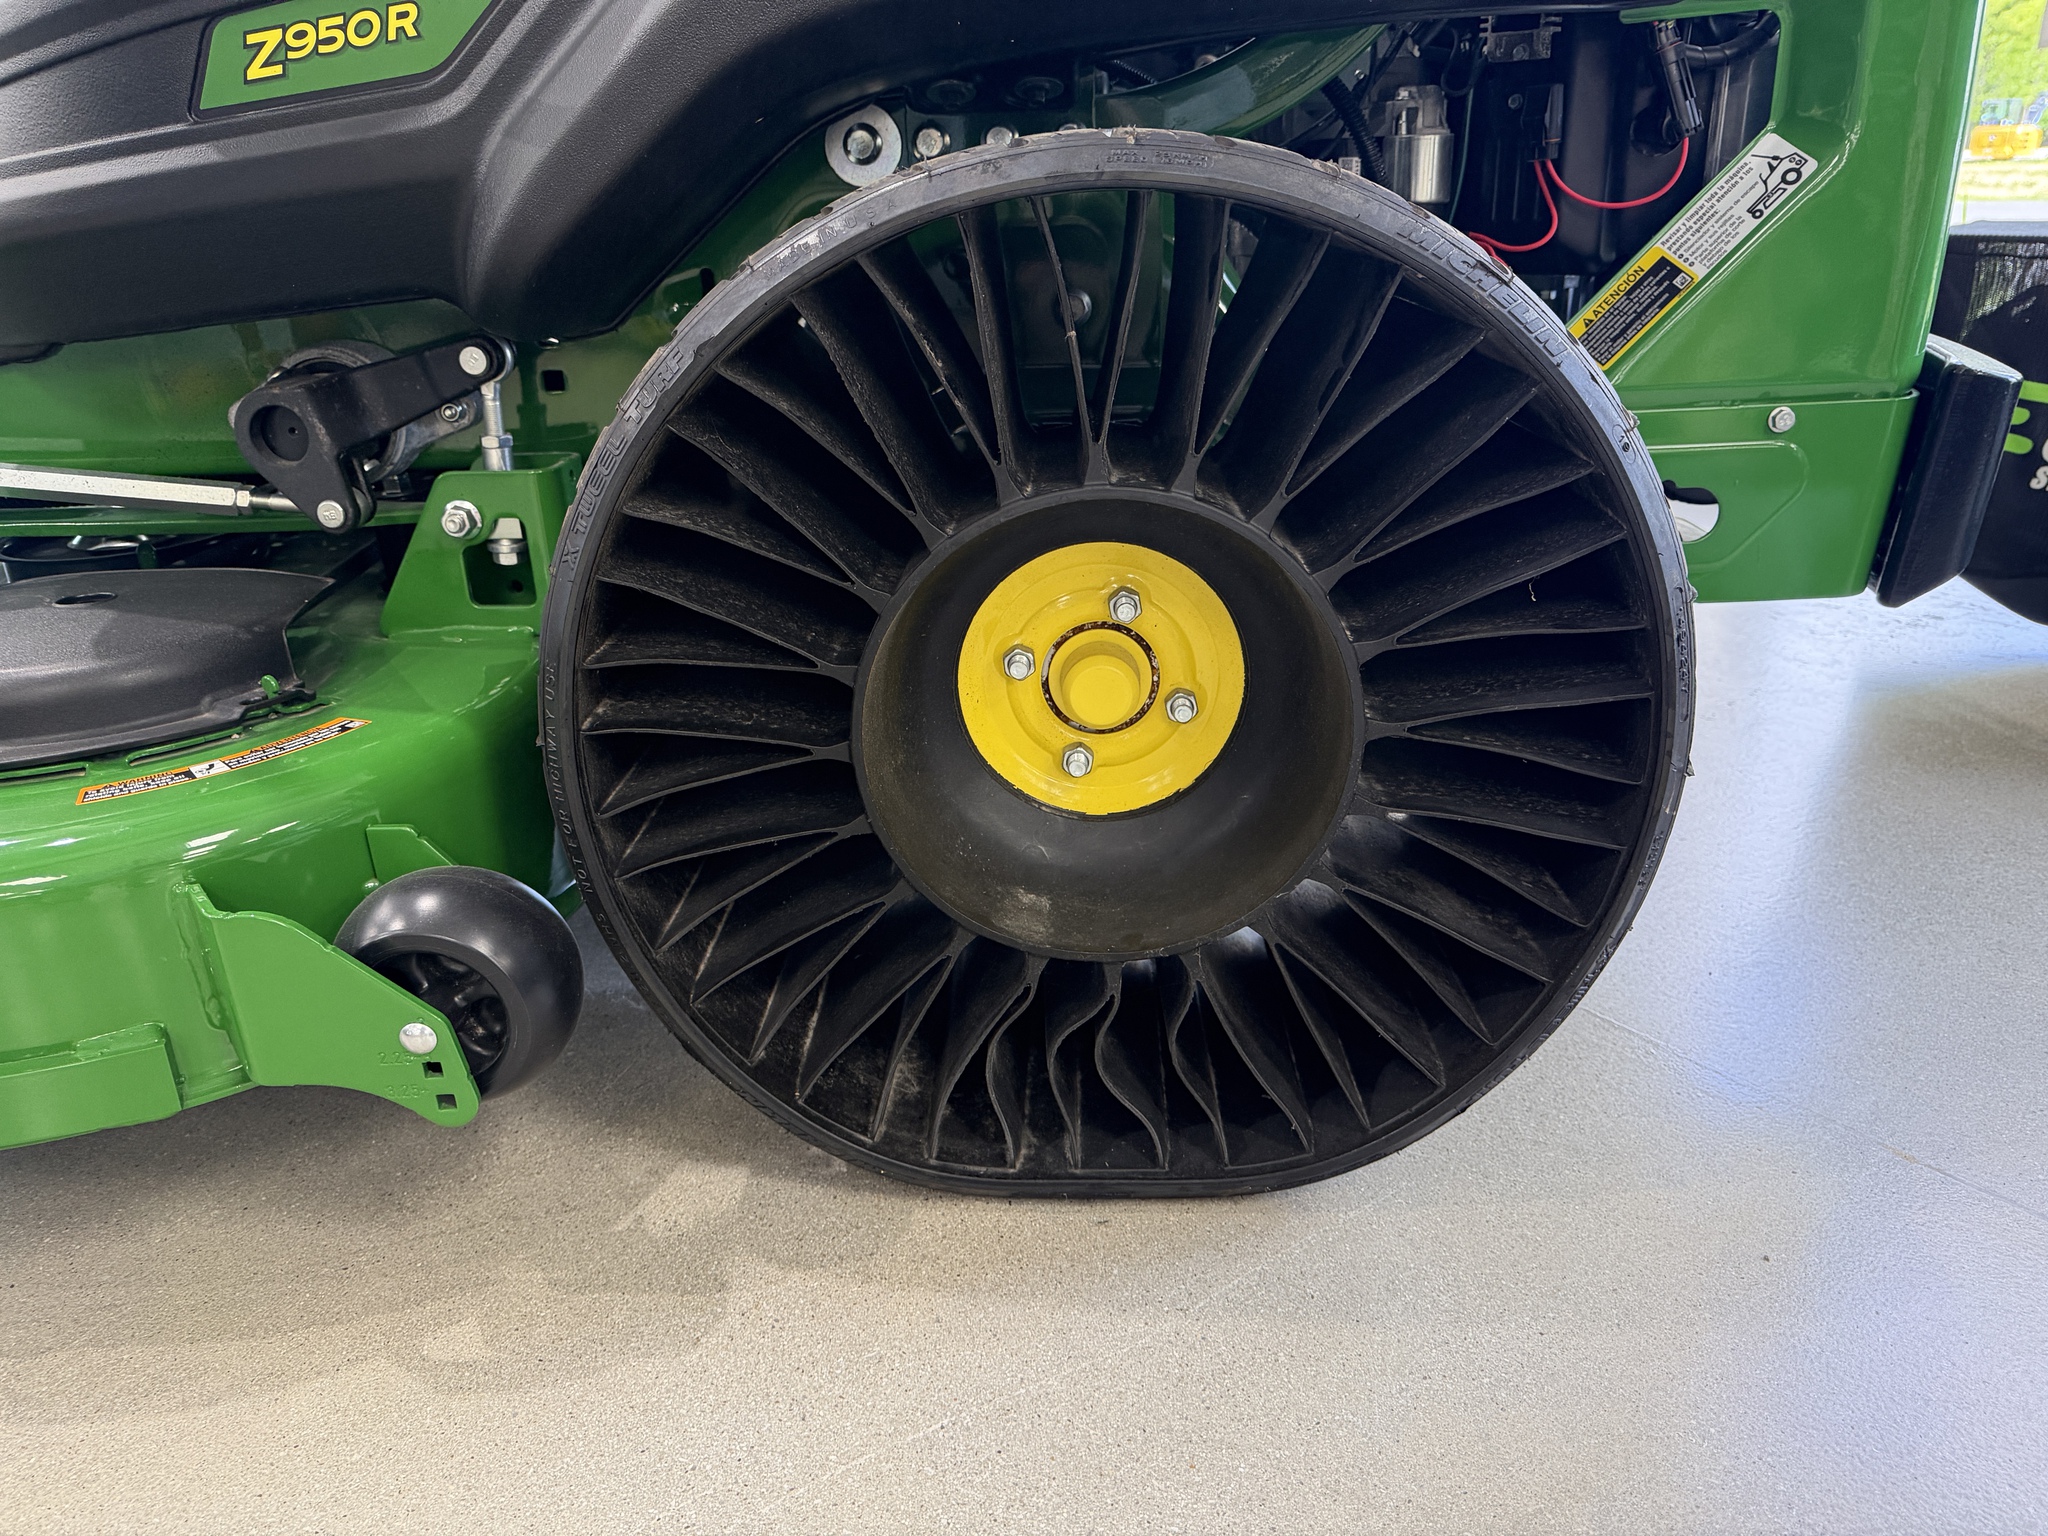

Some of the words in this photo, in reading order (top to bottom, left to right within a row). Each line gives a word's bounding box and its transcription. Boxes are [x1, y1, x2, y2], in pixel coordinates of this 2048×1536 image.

[1660, 225, 1682, 247] Revisar
[1684, 201, 1706, 223] limpiar
[1704, 189, 1718, 203] toda
[1716, 183, 1724, 191] la
[1666, 224, 1693, 251] prestando
[1692, 201, 1716, 226] especial
[1714, 178, 1739, 203] atención
[1742, 165, 1753, 176] los
[1671, 235, 1691, 255] puntos
[1689, 207, 1720, 238] siguientes:
[1397, 220, 1569, 357] MICHELIN
[1592, 265, 1645, 318] ATENCIÓN
[571, 434, 628, 536] TWEEL
[623, 350, 684, 425] TURF
[544, 661, 558, 702] USE
[118, 769, 173, 785] WARNING
[545, 708, 567, 803] HIGHWAY
[558, 809, 579, 852] FOR
[572, 854, 594, 894] NOT
